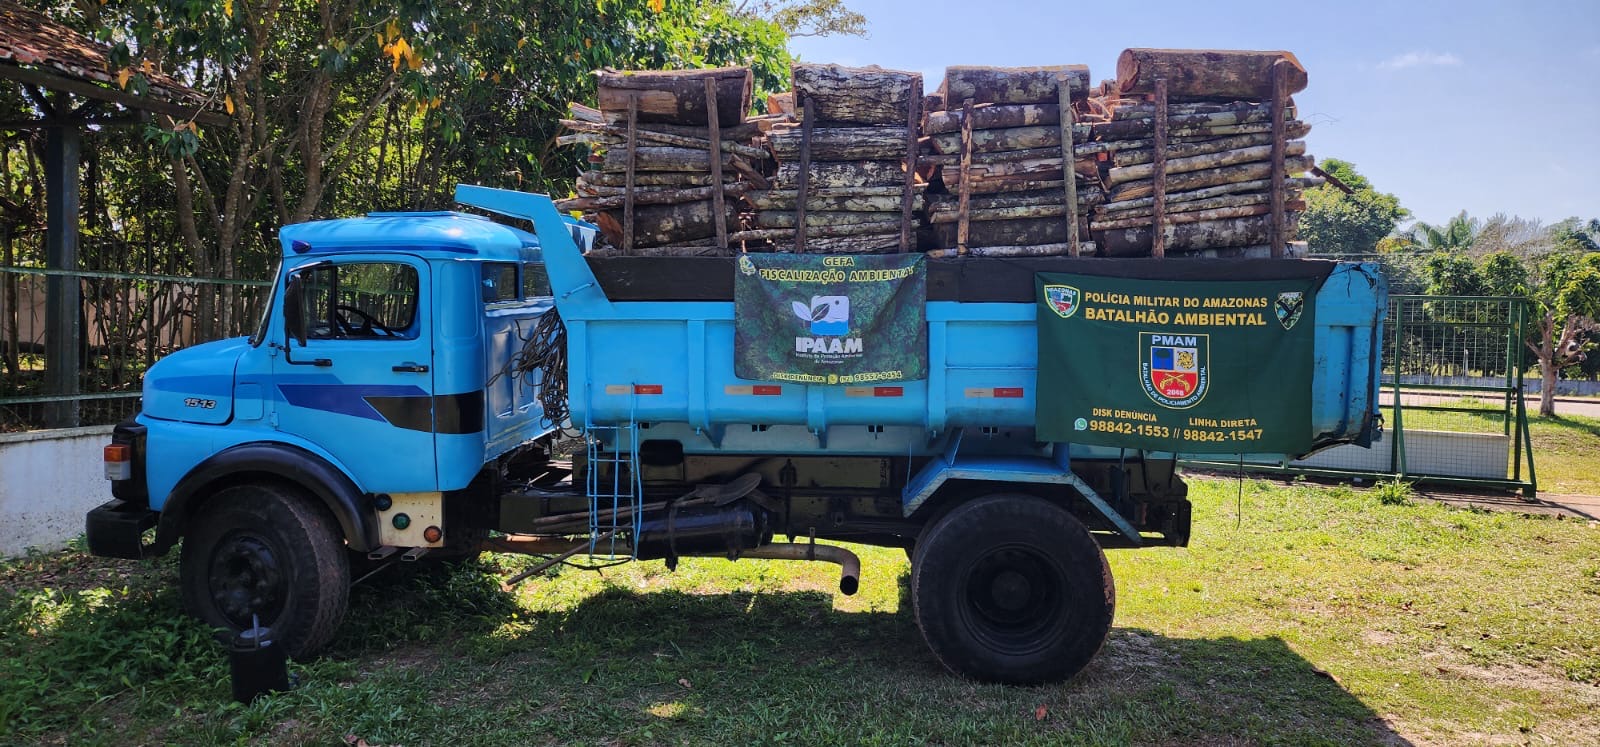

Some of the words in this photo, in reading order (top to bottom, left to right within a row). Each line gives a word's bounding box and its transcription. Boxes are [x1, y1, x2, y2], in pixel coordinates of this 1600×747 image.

[823, 256, 854, 266] GEFA
[759, 267, 846, 285] FISCALIZAÇÃO
[1085, 291, 1130, 305] POLÍCIA
[1133, 295, 1180, 307] MILITAR
[1183, 297, 1199, 308] DO
[1202, 297, 1268, 308] AMAZONAS
[1085, 307, 1170, 324] BATALHÃO
[1174, 313, 1267, 326] AMBIENTAL
[796, 336, 863, 354] IPAAM
[1151, 335, 1197, 346] PMAM
[1092, 408, 1113, 418] DISK
[1114, 409, 1157, 422] DENÚNCIA
[1189, 417, 1218, 428] LINHA
[1220, 418, 1257, 428] DIRETA
[1089, 419, 1170, 438] 98842-1553
[1183, 429, 1264, 442] 98842-1547
